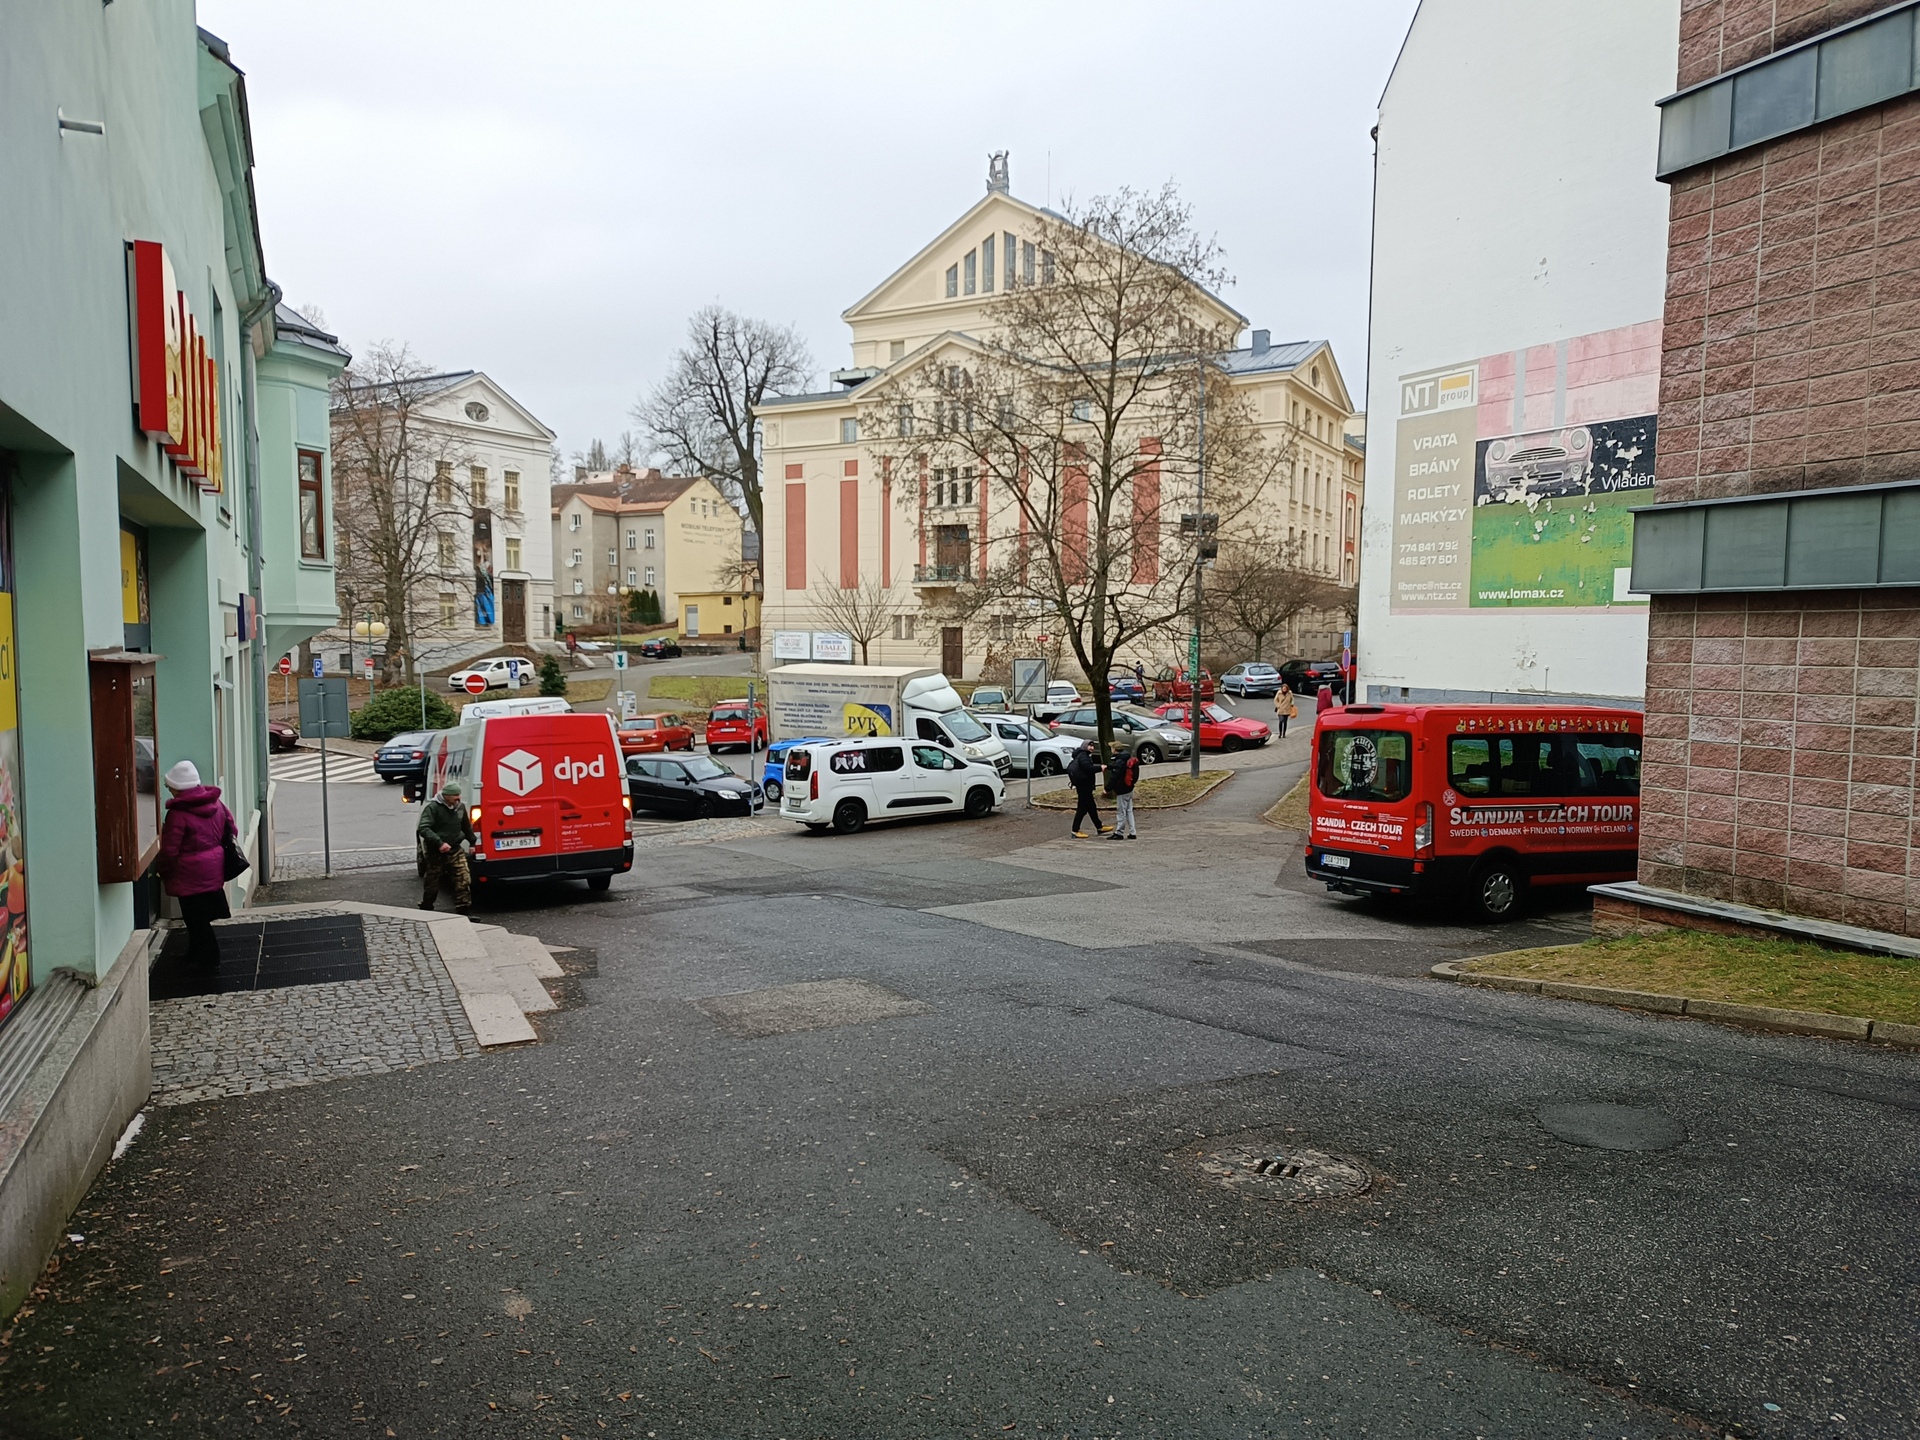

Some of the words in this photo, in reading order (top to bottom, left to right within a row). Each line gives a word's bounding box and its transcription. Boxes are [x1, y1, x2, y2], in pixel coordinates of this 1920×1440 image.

[1404, 381, 1435, 411] NT
[1440, 389, 1469, 405] group
[1412, 432, 1459, 451] VRATA
[1408, 456, 1461, 477] BRÁNY
[1407, 483, 1462, 501] ROLETY
[1399, 506, 1468, 526] MARKÝZY
[1399, 543, 1418, 554] 774
[1418, 542, 1436, 552] 841
[1438, 540, 1459, 551] 792
[1398, 556, 1419, 566] 485
[1419, 555, 1437, 566] 217
[1438, 554, 1458, 564] 501
[1401, 592, 1458, 601] www.ntz.cz
[1478, 587, 1564, 600] www.lomax.cz
[847, 715, 879, 731] PVK
[553, 754, 605, 785] dpd
[1449, 806, 1525, 825] SCANDIA
[1537, 806, 1588, 823] CZECH
[1591, 804, 1633, 822] TOUR
[1316, 816, 1346, 829] SCANDIA
[1350, 820, 1377, 832] CZECH
[1377, 823, 1403, 835] TOUR
[1449, 828, 1480, 837] SWEDEN
[1489, 827, 1523, 836] DENMARK
[1530, 826, 1558, 835] FINLAND
[1566, 825, 1594, 834] NORWAY
[1600, 824, 1627, 833] ICELAND
